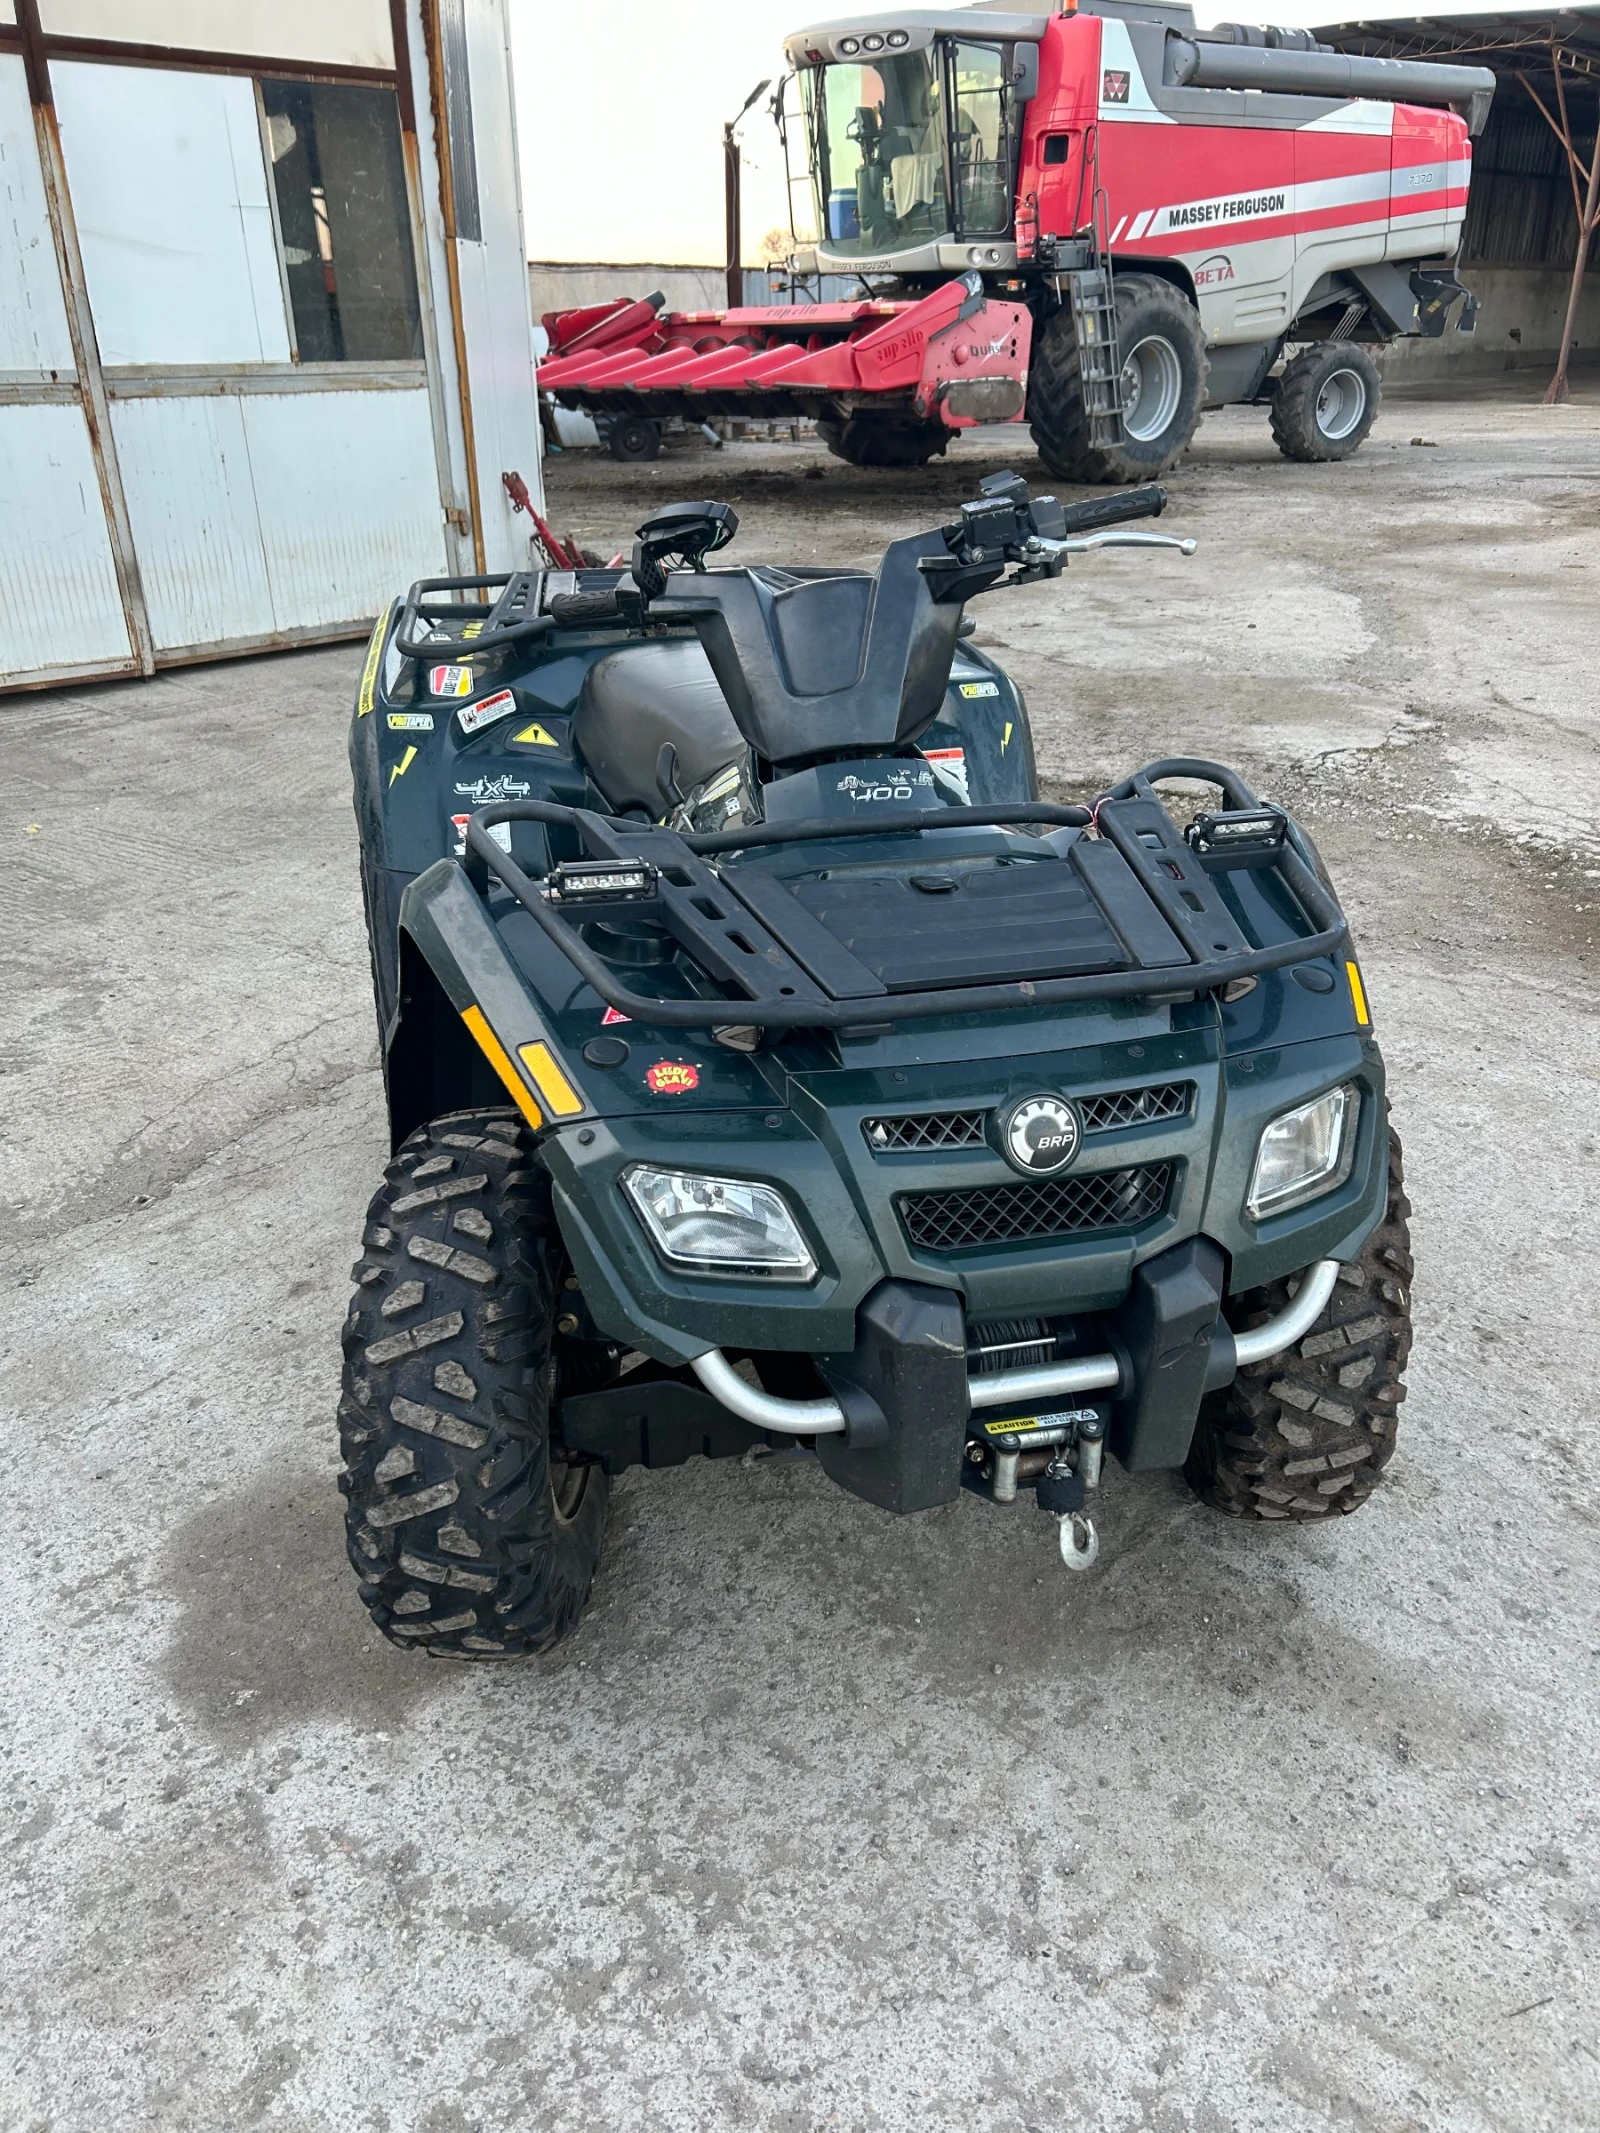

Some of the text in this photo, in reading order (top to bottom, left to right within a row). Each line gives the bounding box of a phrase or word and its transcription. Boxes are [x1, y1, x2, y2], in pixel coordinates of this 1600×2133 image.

[1408, 173, 1433, 186] 7370
[1169, 194, 1285, 227] MASSEY FERGUSON
[1194, 265, 1235, 286] BETA
[653, 1066, 689, 1079] LUDI
[1037, 1134, 1074, 1149] BRP
[996, 1420, 1035, 1430] CAUTION
